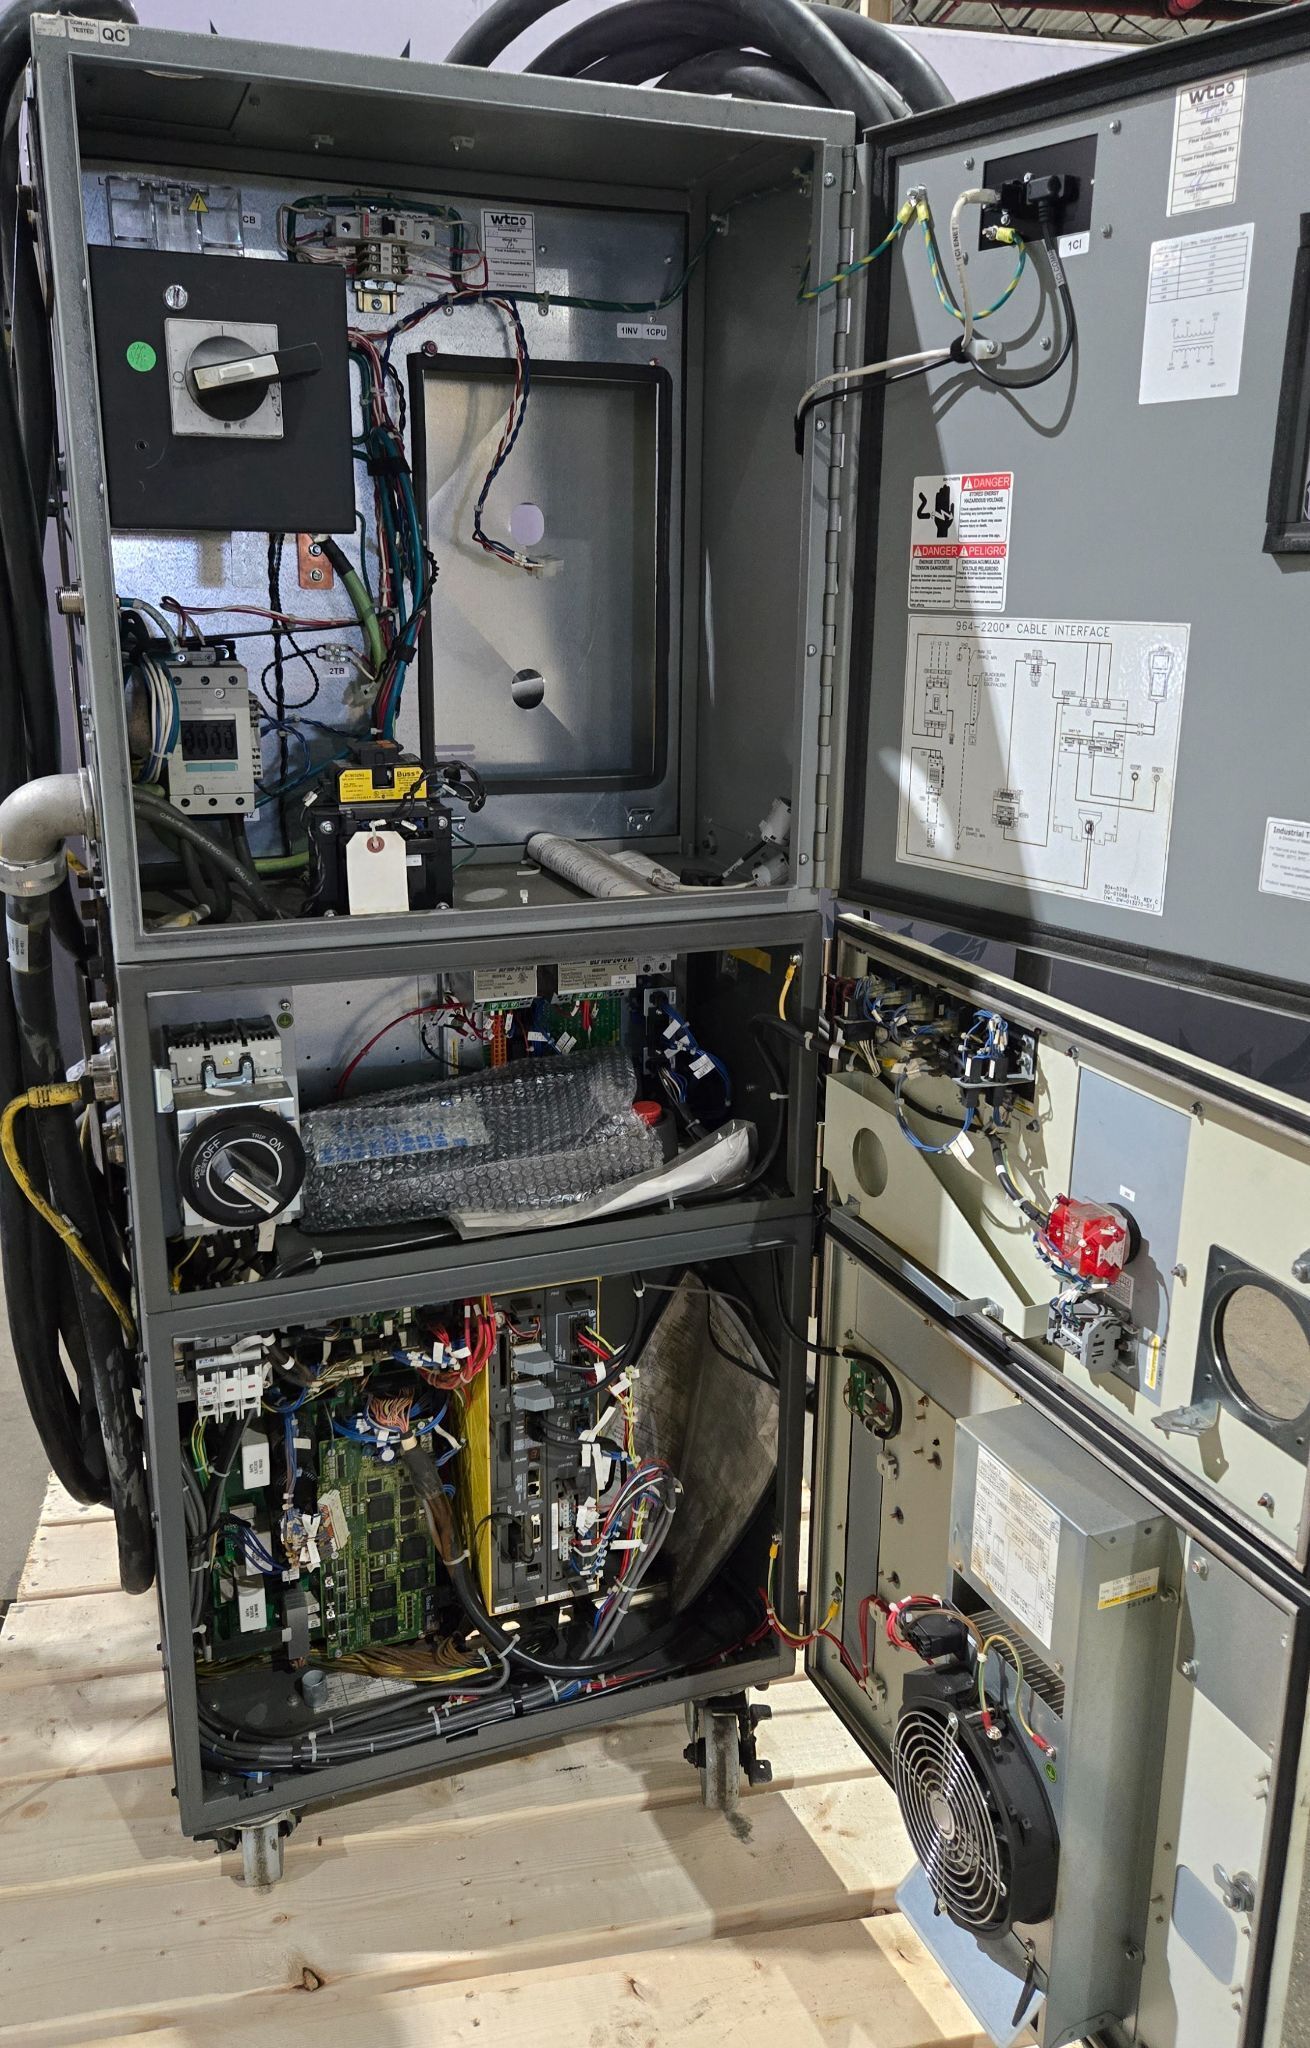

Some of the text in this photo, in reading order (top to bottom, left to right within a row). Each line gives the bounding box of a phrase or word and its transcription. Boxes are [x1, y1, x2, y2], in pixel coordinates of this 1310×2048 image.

[102, 27, 126, 42] QC
[1068, 239, 1082, 251] 1CI
[621, 327, 666, 336] 1INV 1CPU
[973, 477, 1010, 488] DANGER
[922, 546, 957, 556] DANGER
[969, 546, 1006, 556] PELIGRO
[1017, 623, 1047, 635] CABLE
[1055, 625, 1110, 638] INTERFACE
[1273, 826, 1304, 838] Industrial
[203, 1139, 220, 1159] OFF
[269, 1137, 285, 1152] ON
